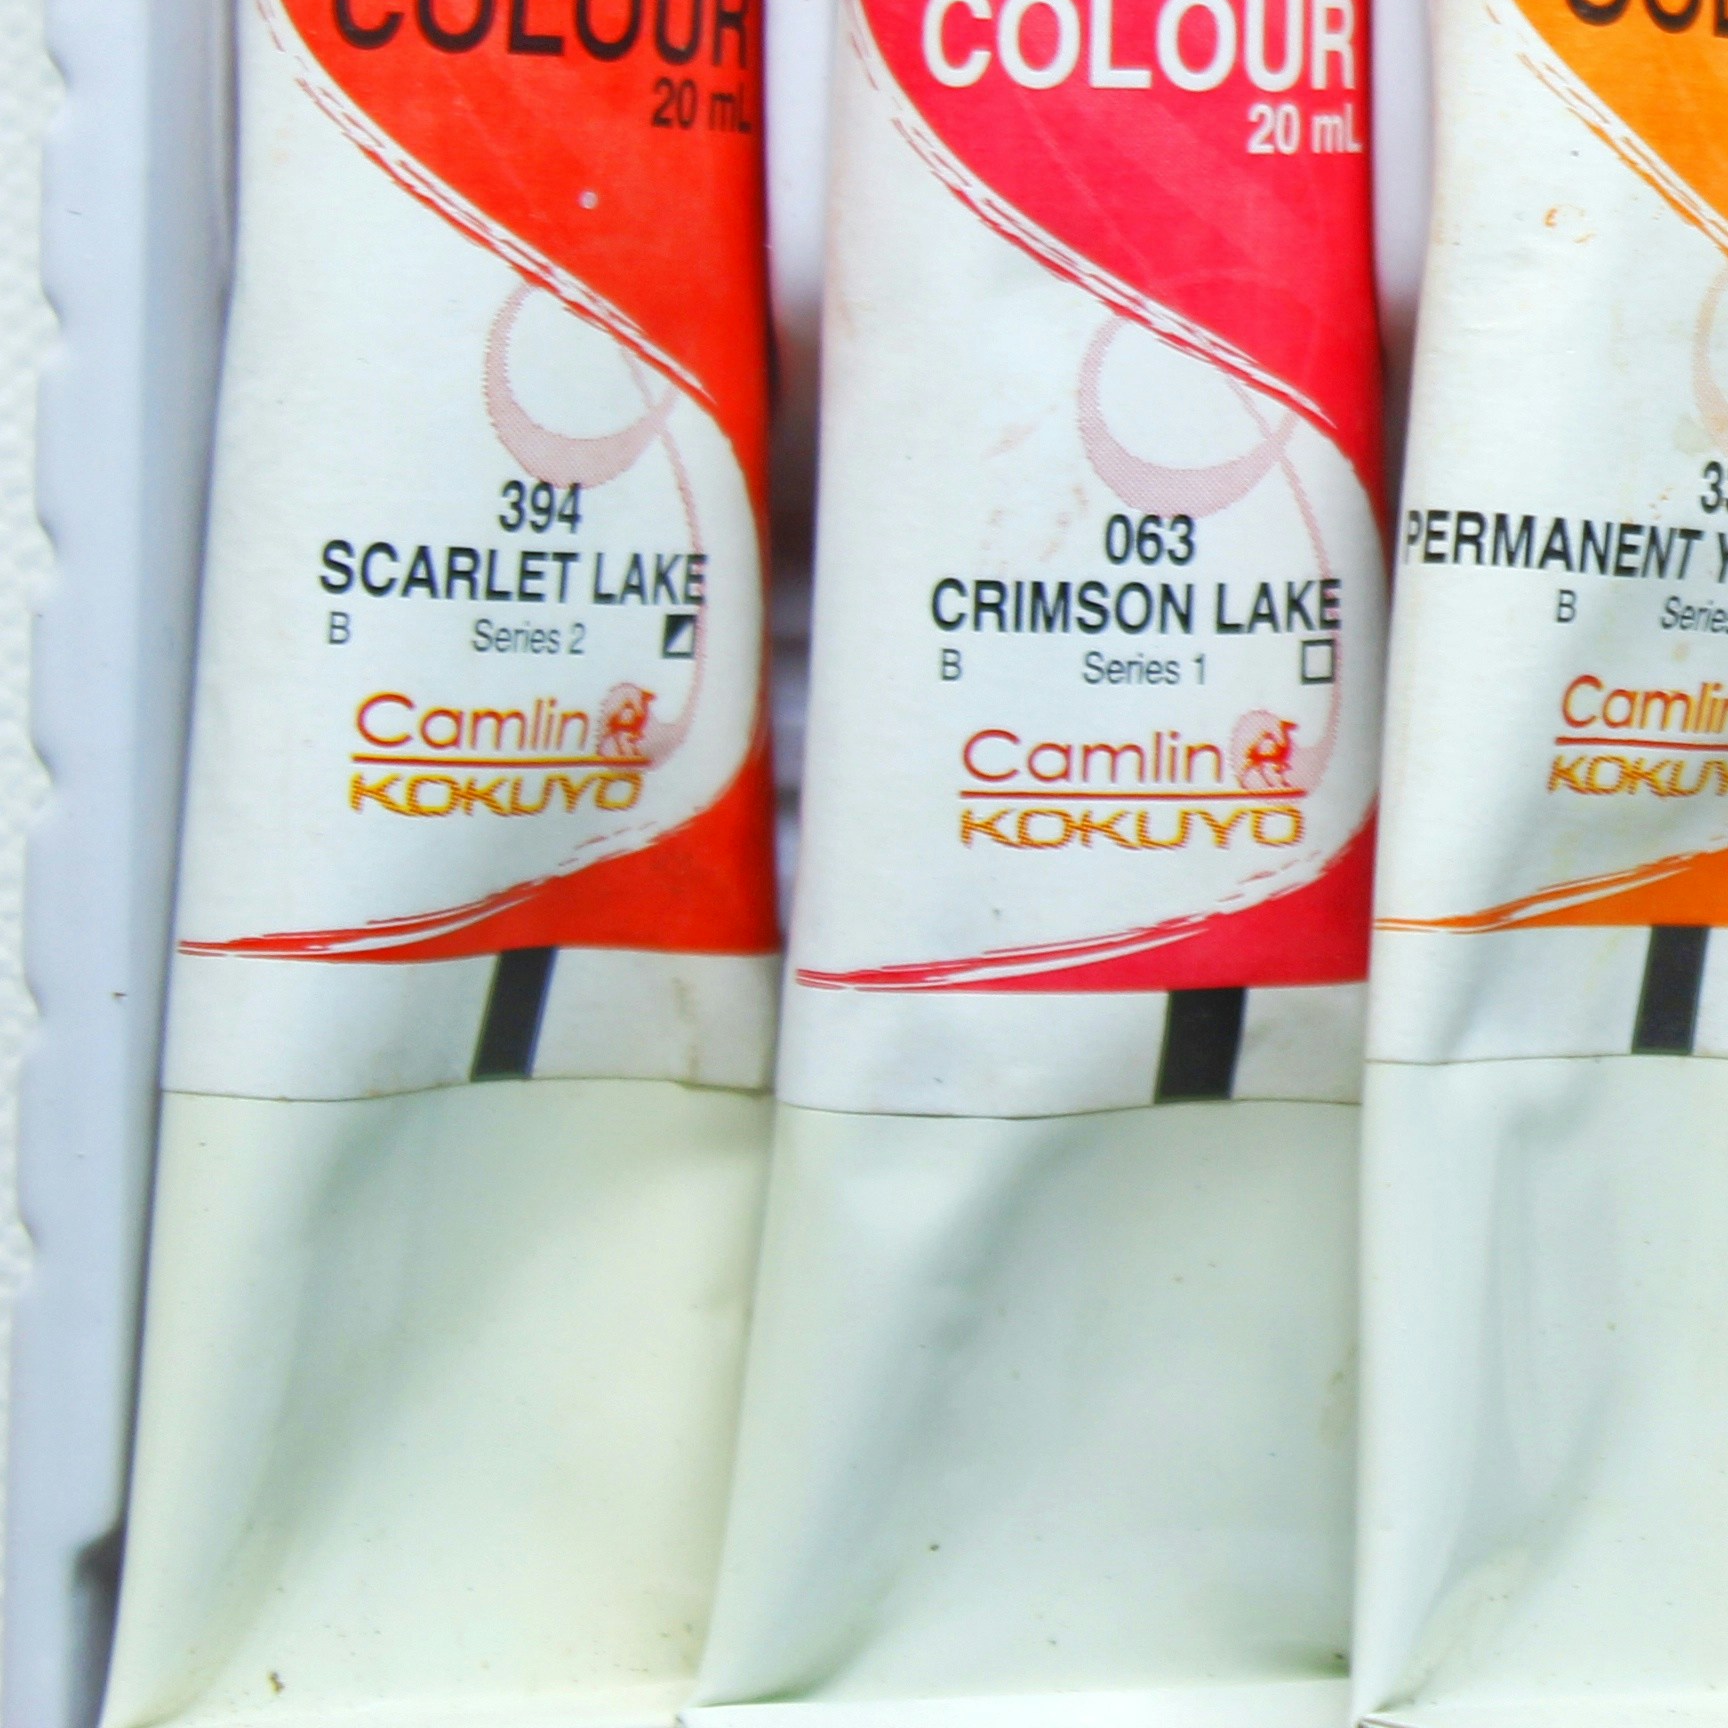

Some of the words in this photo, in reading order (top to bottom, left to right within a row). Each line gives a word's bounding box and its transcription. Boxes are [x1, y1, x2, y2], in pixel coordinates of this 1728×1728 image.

[650, 76, 696, 129] 20
[707, 81, 753, 134] mL
[1248, 104, 1299, 155] 20
[1311, 104, 1362, 154] mL
[499, 480, 582, 534] 394
[1105, 513, 1196, 566] 063
[1404, 508, 1705, 581] PERMANENT
[318, 538, 580, 604] SCARLET
[592, 551, 709, 606] LAKE
[932, 577, 1196, 636] CRIMSON
[1215, 578, 1342, 635] LAKE
[1555, 589, 1577, 624] B
[328, 612, 351, 645] B
[472, 619, 561, 654] Series
[568, 623, 586, 655] 2
[940, 648, 962, 682] B
[1083, 650, 1182, 686] Series
[1193, 653, 1208, 686] 1
[356, 691, 590, 751] Camlin
[962, 728, 1224, 785] Camlin
[349, 773, 643, 817] KOKUYO
[959, 807, 1306, 850] KOKUYO
